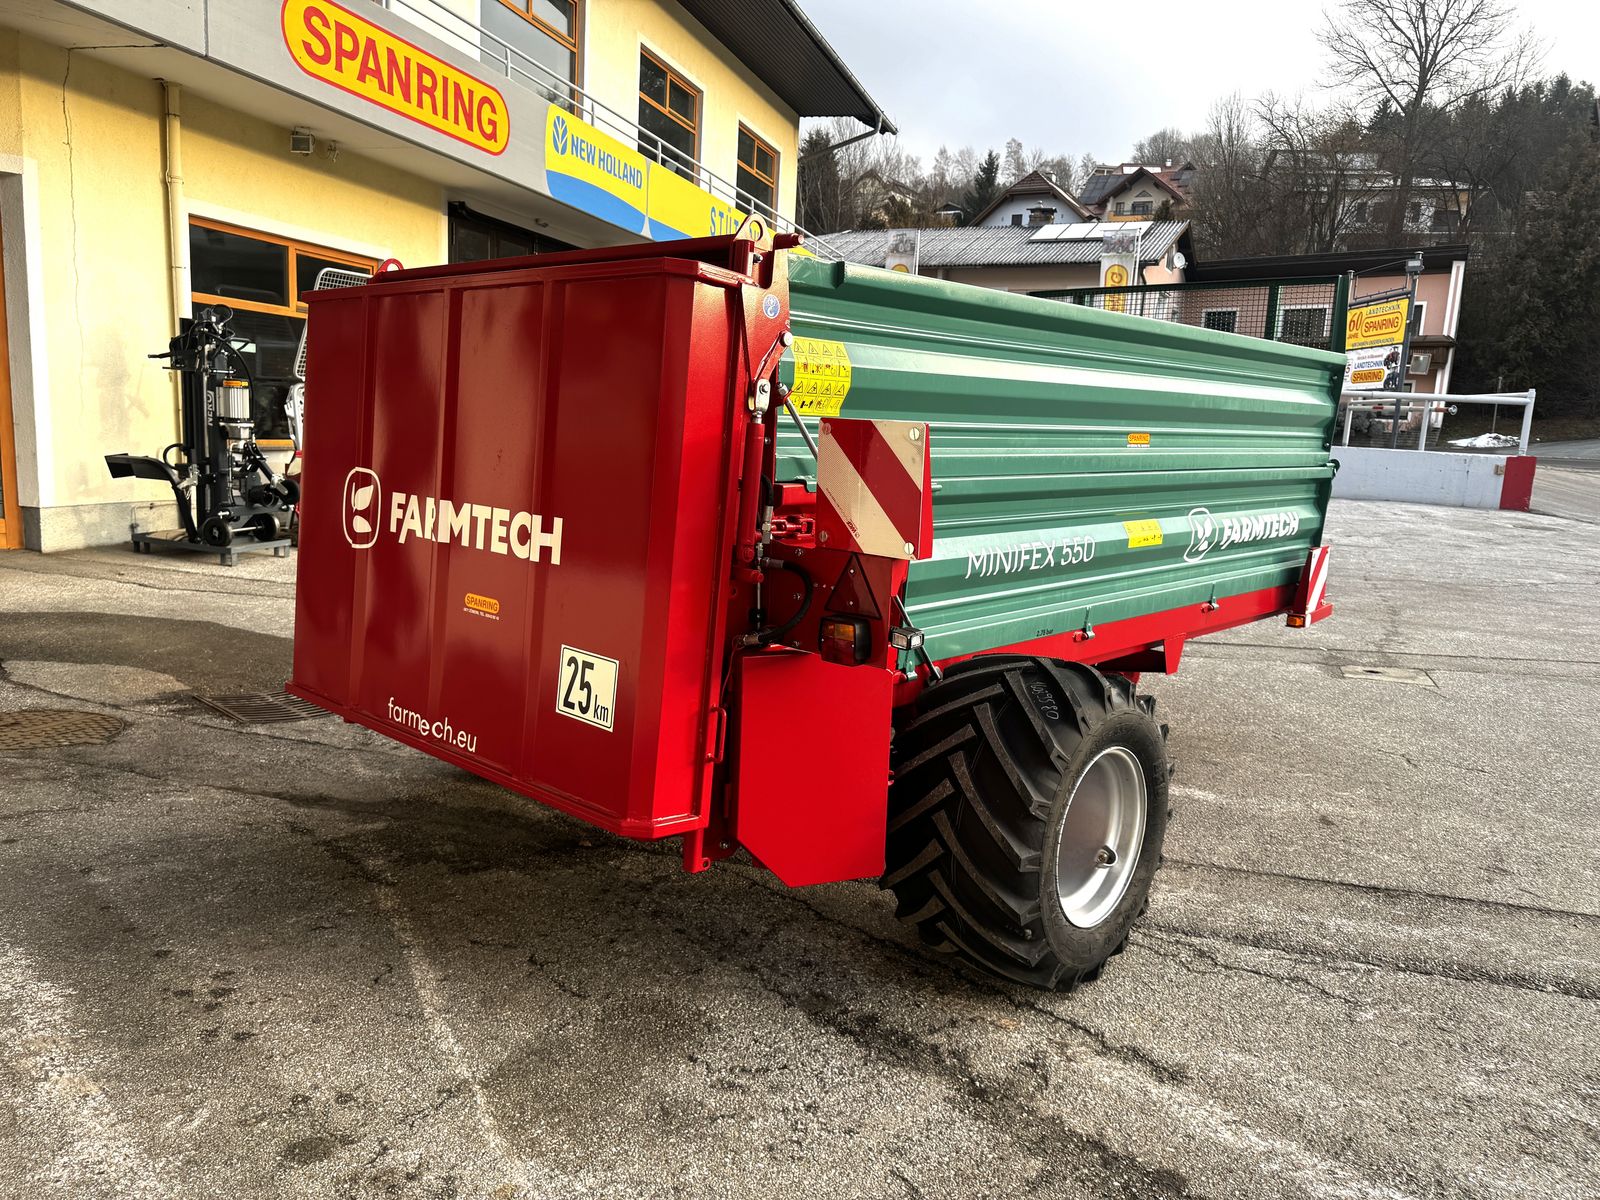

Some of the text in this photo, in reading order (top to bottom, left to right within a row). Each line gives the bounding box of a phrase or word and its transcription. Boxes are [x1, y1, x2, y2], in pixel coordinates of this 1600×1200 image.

[302, 6, 498, 143] SPANRING
[571, 133, 643, 190] NEW HOLLAND
[1349, 311, 1363, 332] 60
[1364, 317, 1399, 333] SPANRING
[1366, 304, 1400, 315] LANDTECHNIK
[1353, 371, 1382, 382] SPANRING
[1354, 360, 1384, 369] LANDTECHNIK
[390, 491, 563, 566] FARMTECH
[1219, 511, 1300, 549] FARMTECH
[965, 535, 1096, 579] MINIFEX 550
[466, 595, 498, 612] SPANRING
[563, 656, 609, 723] 25 km
[388, 697, 477, 753] farmech.eu
